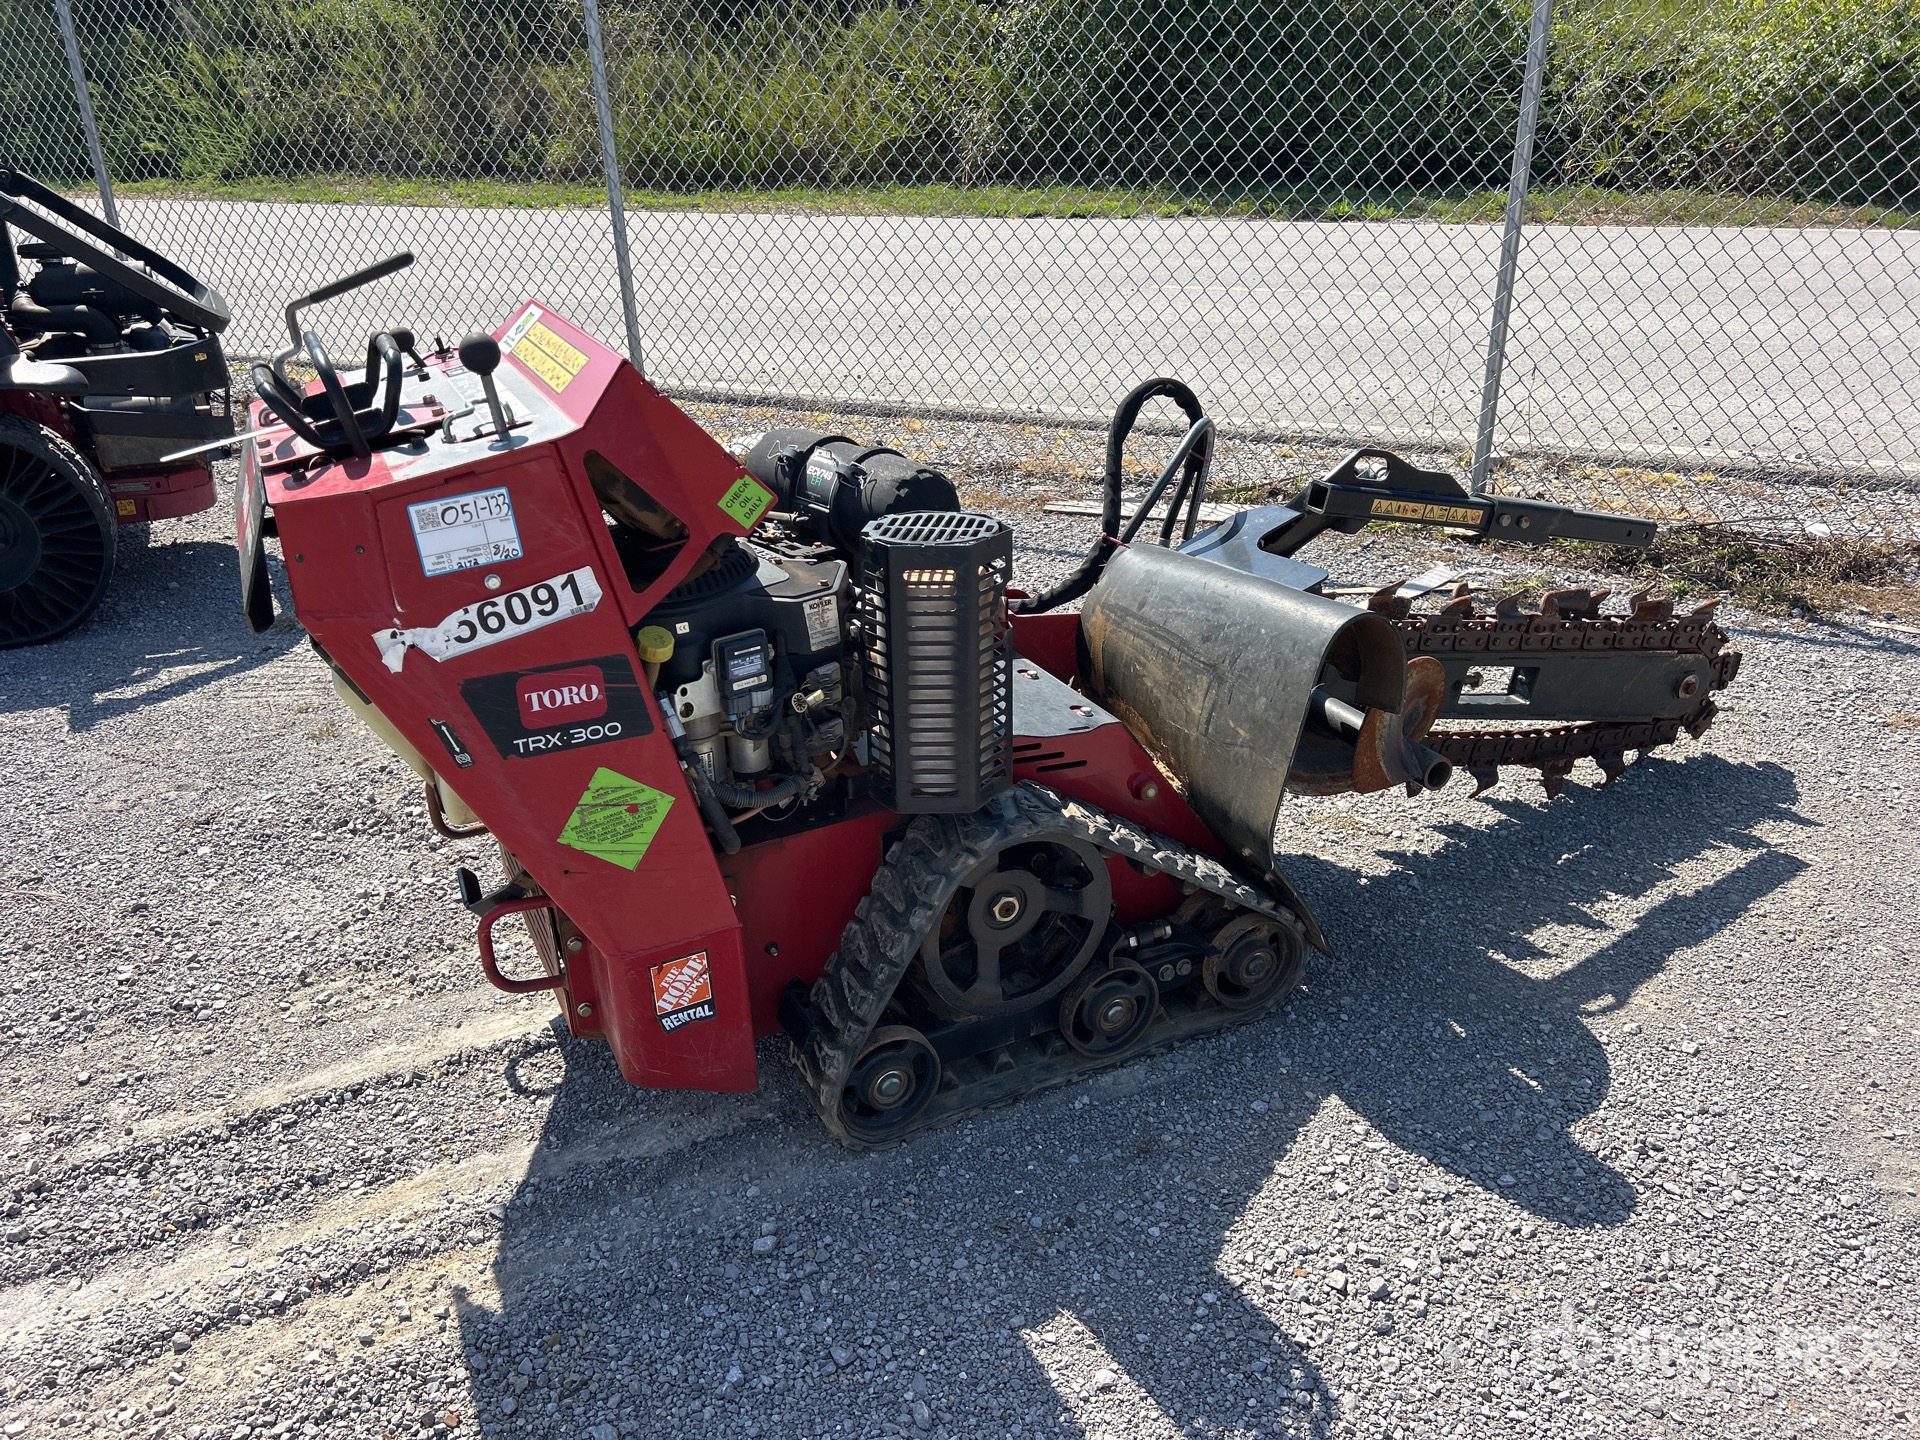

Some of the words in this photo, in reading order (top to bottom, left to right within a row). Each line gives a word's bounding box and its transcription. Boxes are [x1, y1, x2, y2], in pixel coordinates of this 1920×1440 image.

[725, 480, 751, 509] CHECK
[739, 495, 753, 508] OIL
[441, 493, 510, 525] 051-133
[744, 496, 764, 520] DAILY
[493, 544, 519, 559] 8/20
[809, 599, 832, 610] KOHLER
[524, 683, 599, 712] TORO
[657, 955, 706, 1011] HOME
[660, 966, 681, 988] THE
[662, 1004, 714, 1030] RENTAL
